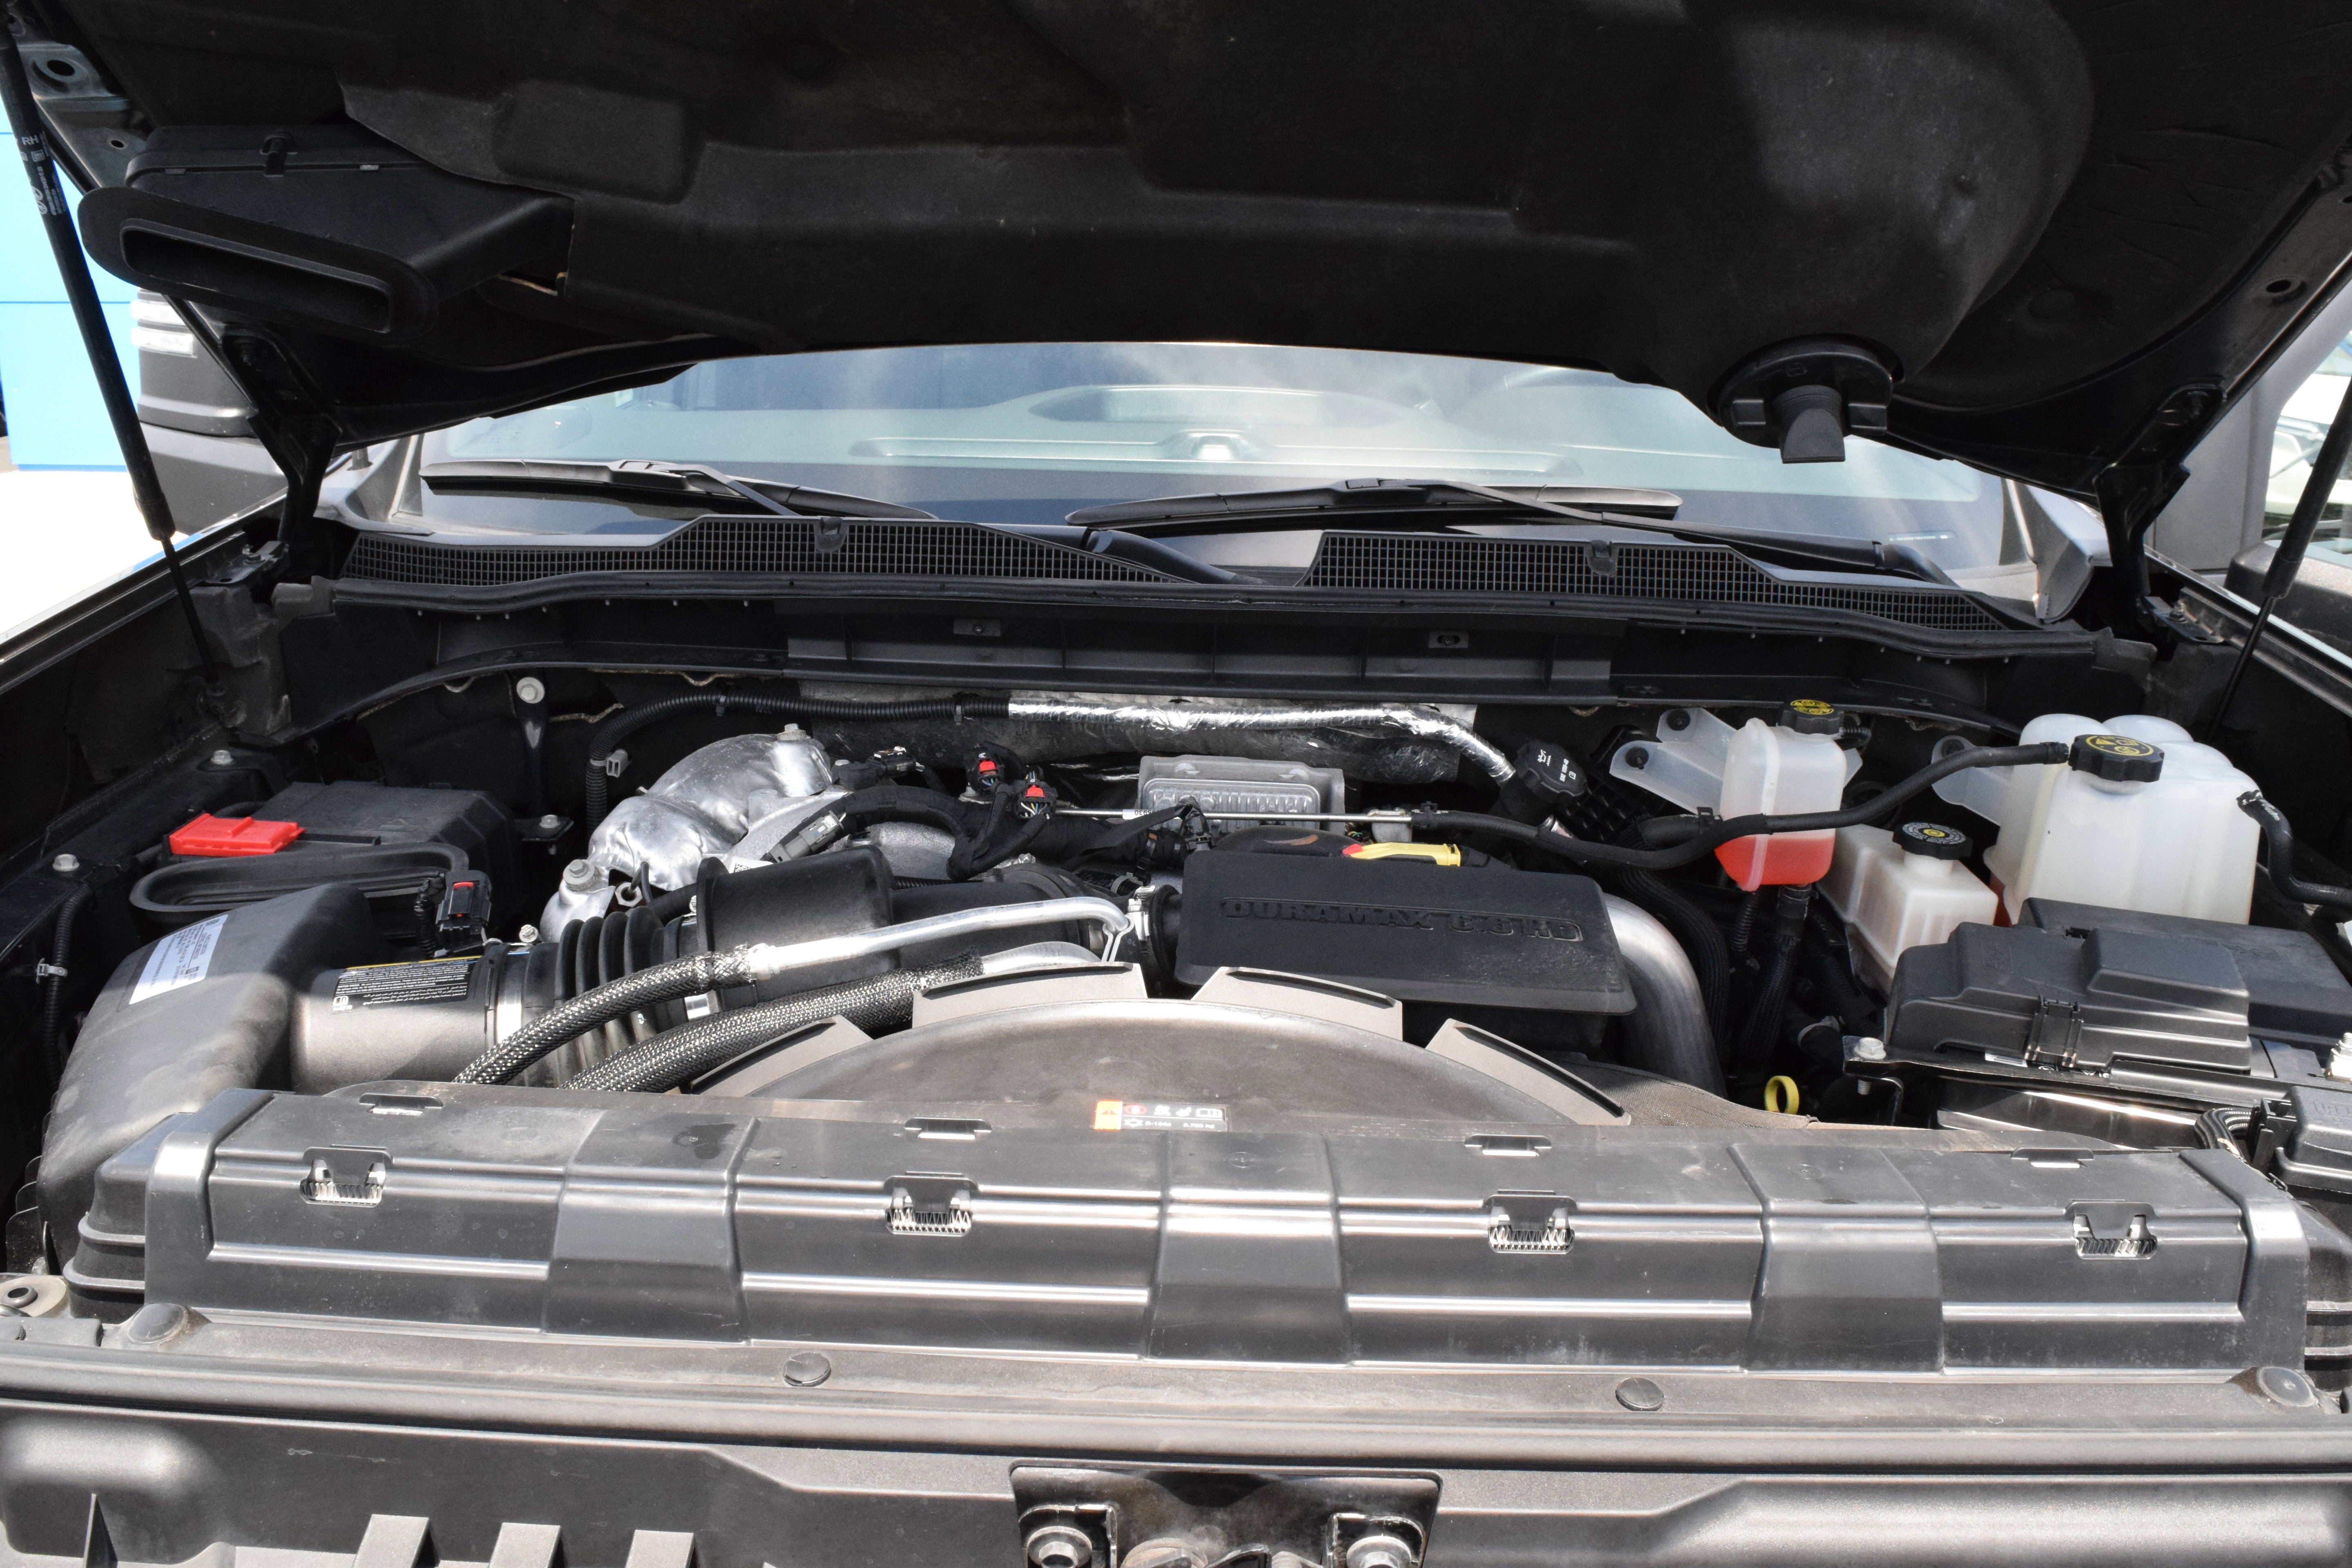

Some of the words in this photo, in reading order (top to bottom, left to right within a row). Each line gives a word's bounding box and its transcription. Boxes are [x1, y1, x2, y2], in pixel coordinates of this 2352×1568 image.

[22, 135, 39, 145] RH
[1224, 899, 1433, 930] DURAMAX
[1450, 913, 1514, 935] 6.6
[1522, 918, 1583, 942] HD
